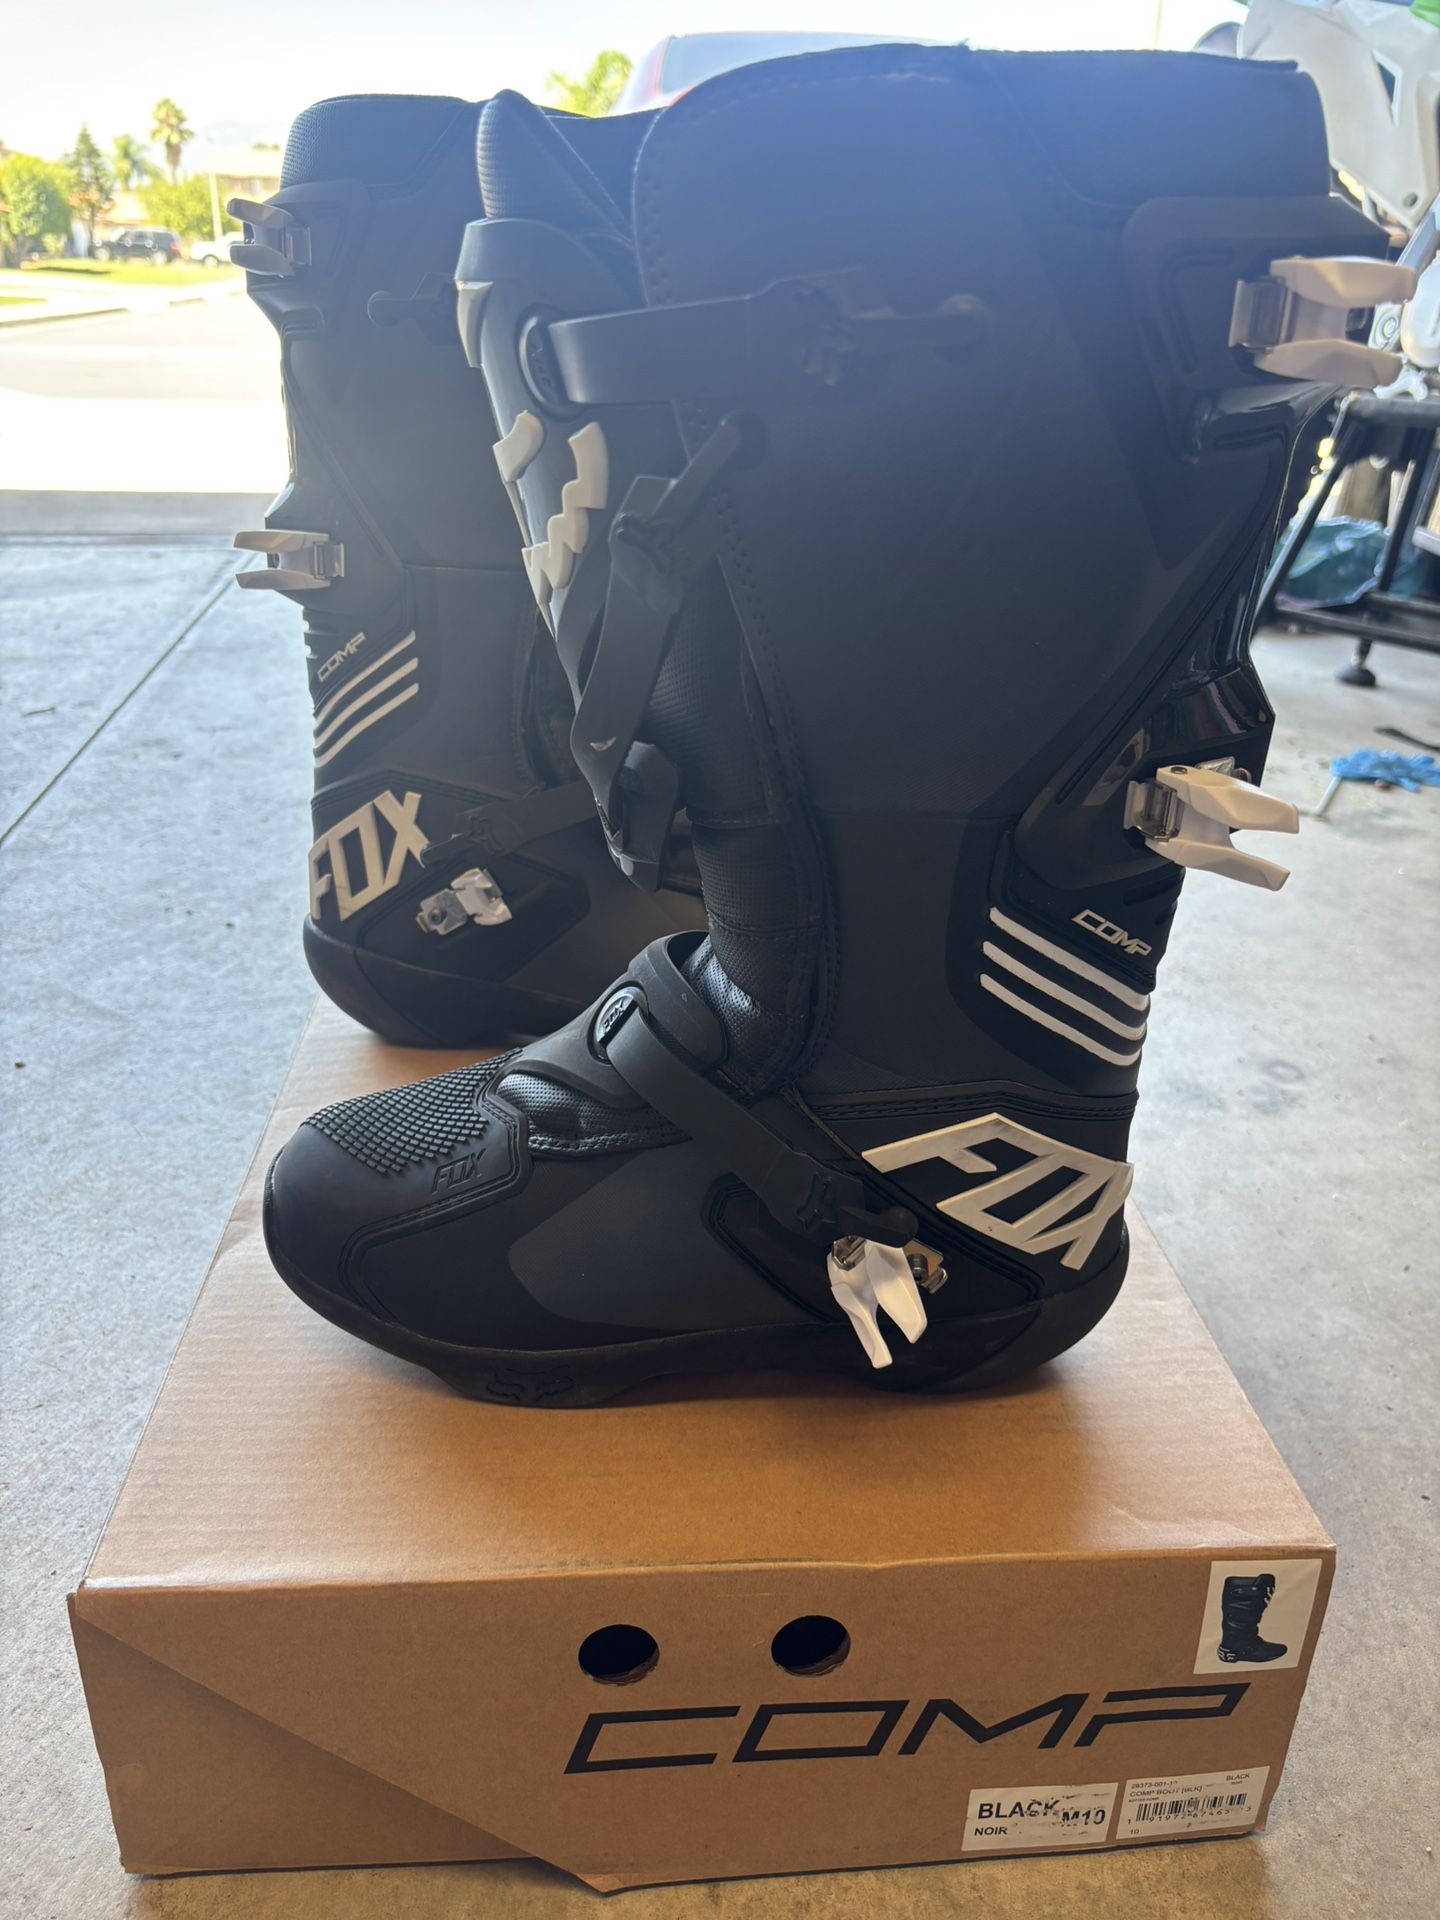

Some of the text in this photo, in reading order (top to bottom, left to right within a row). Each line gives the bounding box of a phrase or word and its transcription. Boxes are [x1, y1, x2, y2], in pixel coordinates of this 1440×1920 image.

[317, 632, 366, 682] COMP
[308, 790, 429, 922] FOX
[1072, 908, 1152, 956] COMP
[431, 1148, 487, 1195] FOX
[563, 1682, 1251, 1775] COMP
[974, 1826, 1008, 1836] NOIR
[978, 1799, 1060, 1819] BLACK
